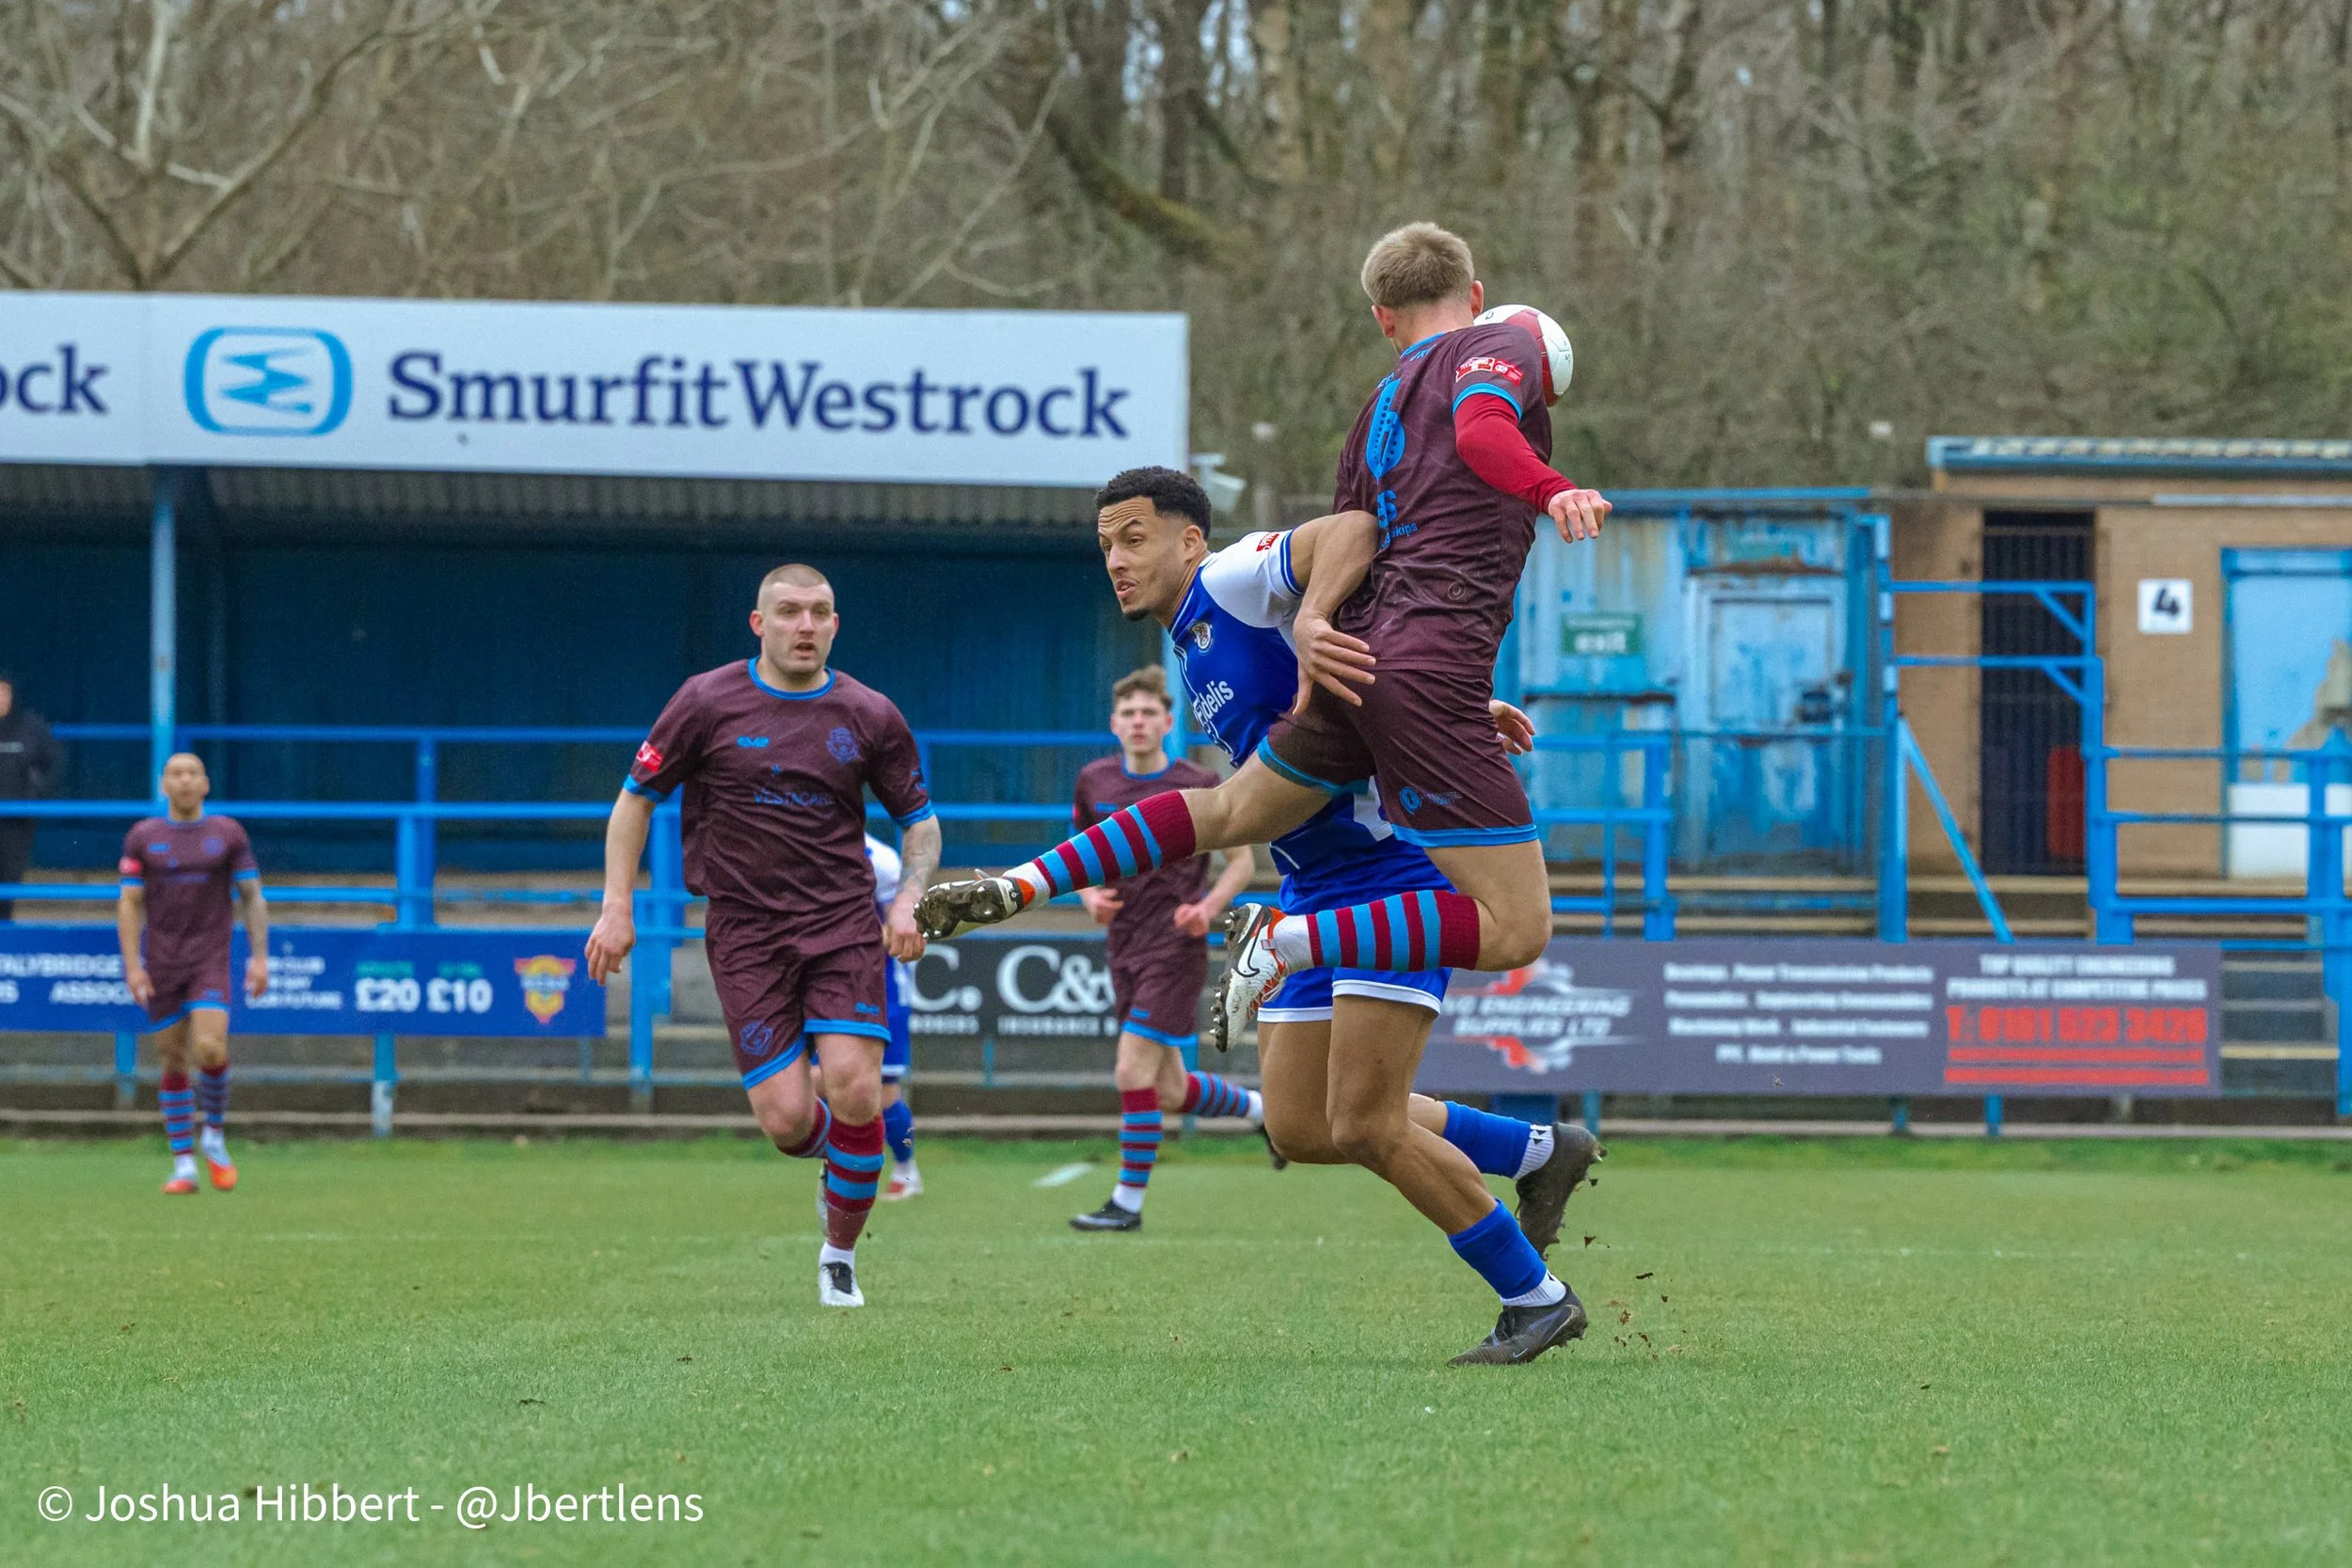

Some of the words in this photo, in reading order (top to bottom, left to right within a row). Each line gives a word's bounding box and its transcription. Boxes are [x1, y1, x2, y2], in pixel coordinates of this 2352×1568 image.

[0, 342, 109, 416] ck
[387, 349, 1131, 439] SmurfitWestrock
[2152, 586, 2181, 618] 4
[0, 954, 122, 978] ALYBRIDGE
[356, 976, 421, 1013] £20
[426, 976, 494, 1014] £10
